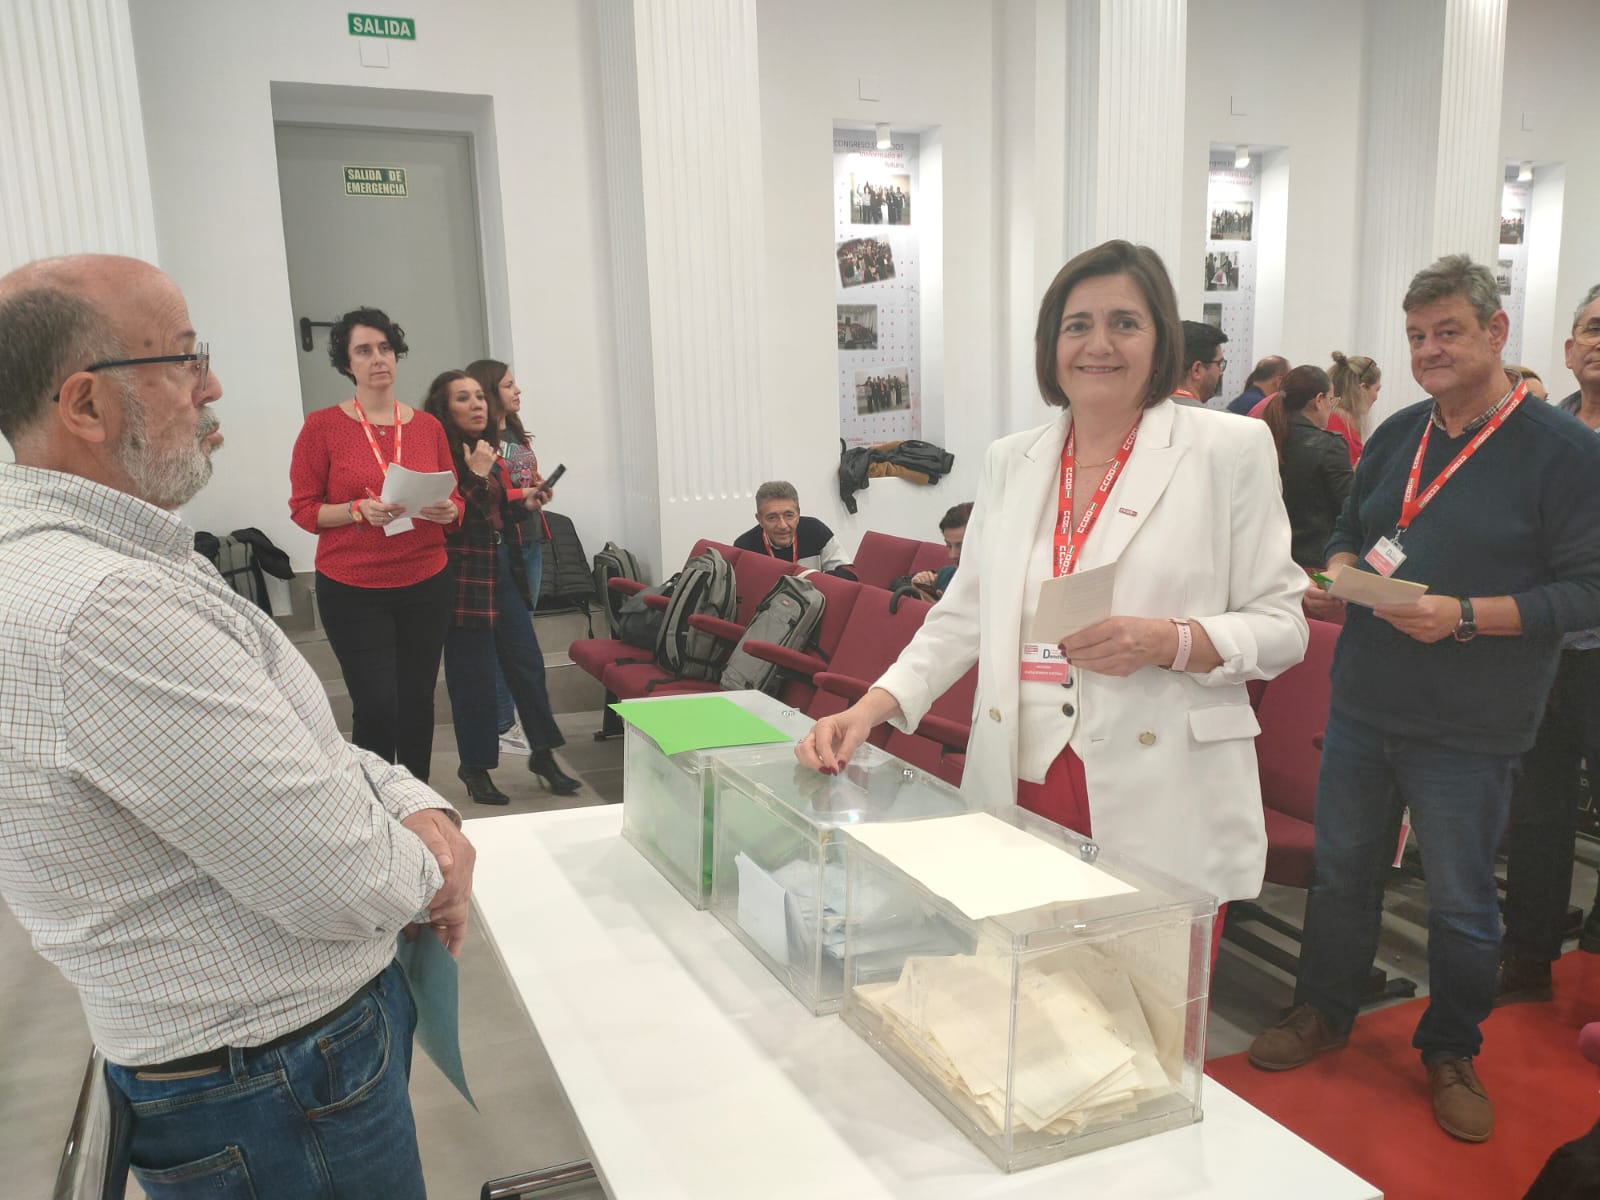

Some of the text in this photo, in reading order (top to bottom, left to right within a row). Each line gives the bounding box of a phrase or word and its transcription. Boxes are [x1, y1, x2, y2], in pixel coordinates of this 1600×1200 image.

[352, 16, 411, 37] SALIDA
[347, 169, 402, 182] SALIDA DE
[346, 181, 405, 195] EMERGENCIA
[1099, 468, 1117, 492] CCOO
[1077, 510, 1093, 533] CCOO
